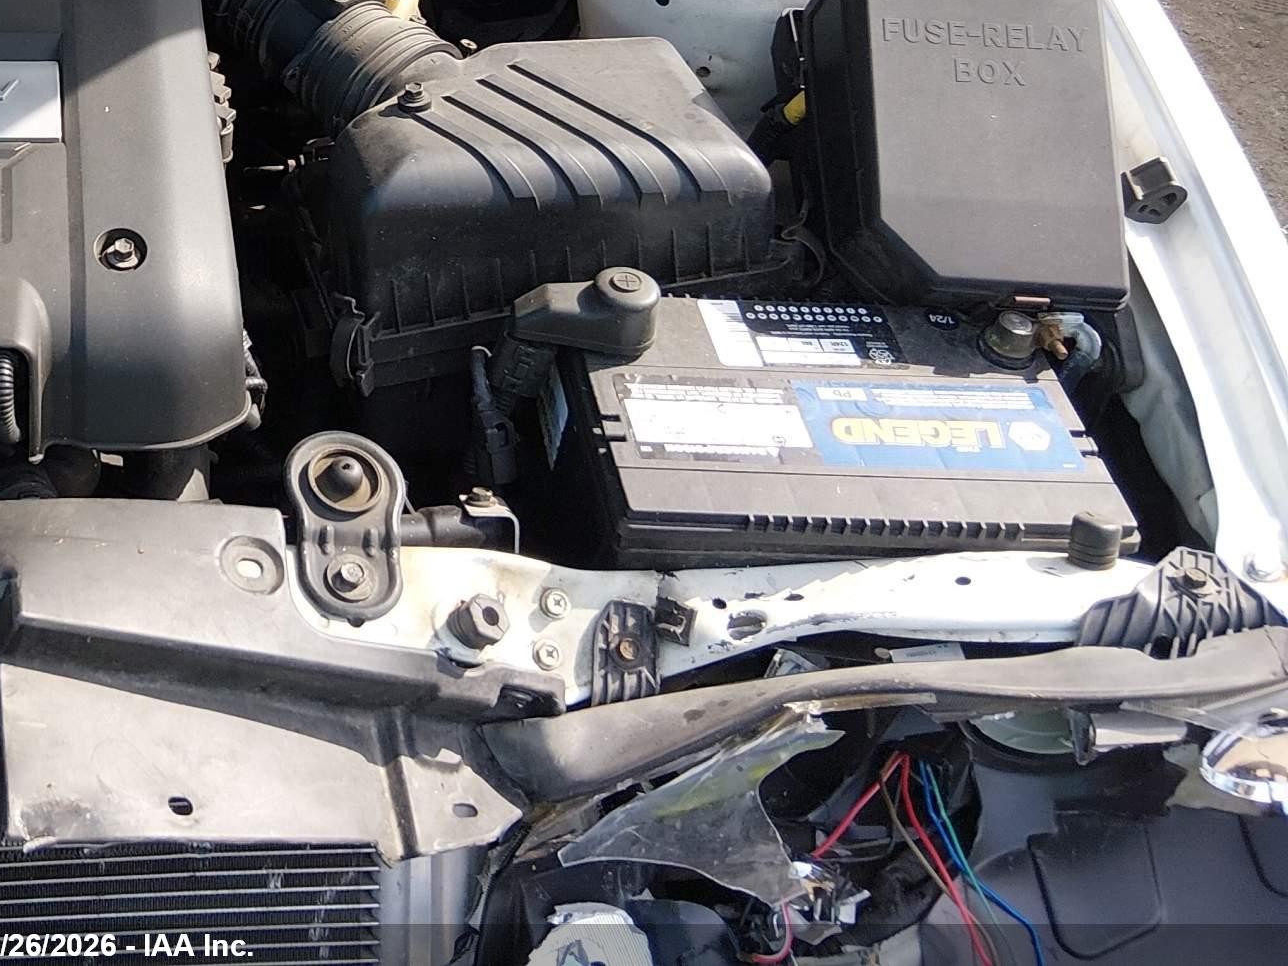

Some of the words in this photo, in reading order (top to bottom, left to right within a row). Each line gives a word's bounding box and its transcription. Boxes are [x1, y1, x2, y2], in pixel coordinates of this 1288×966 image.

[881, 17, 1088, 52] FUSE-RELAY
[953, 57, 1025, 86] BOX
[831, 417, 1006, 449] LEGEND
